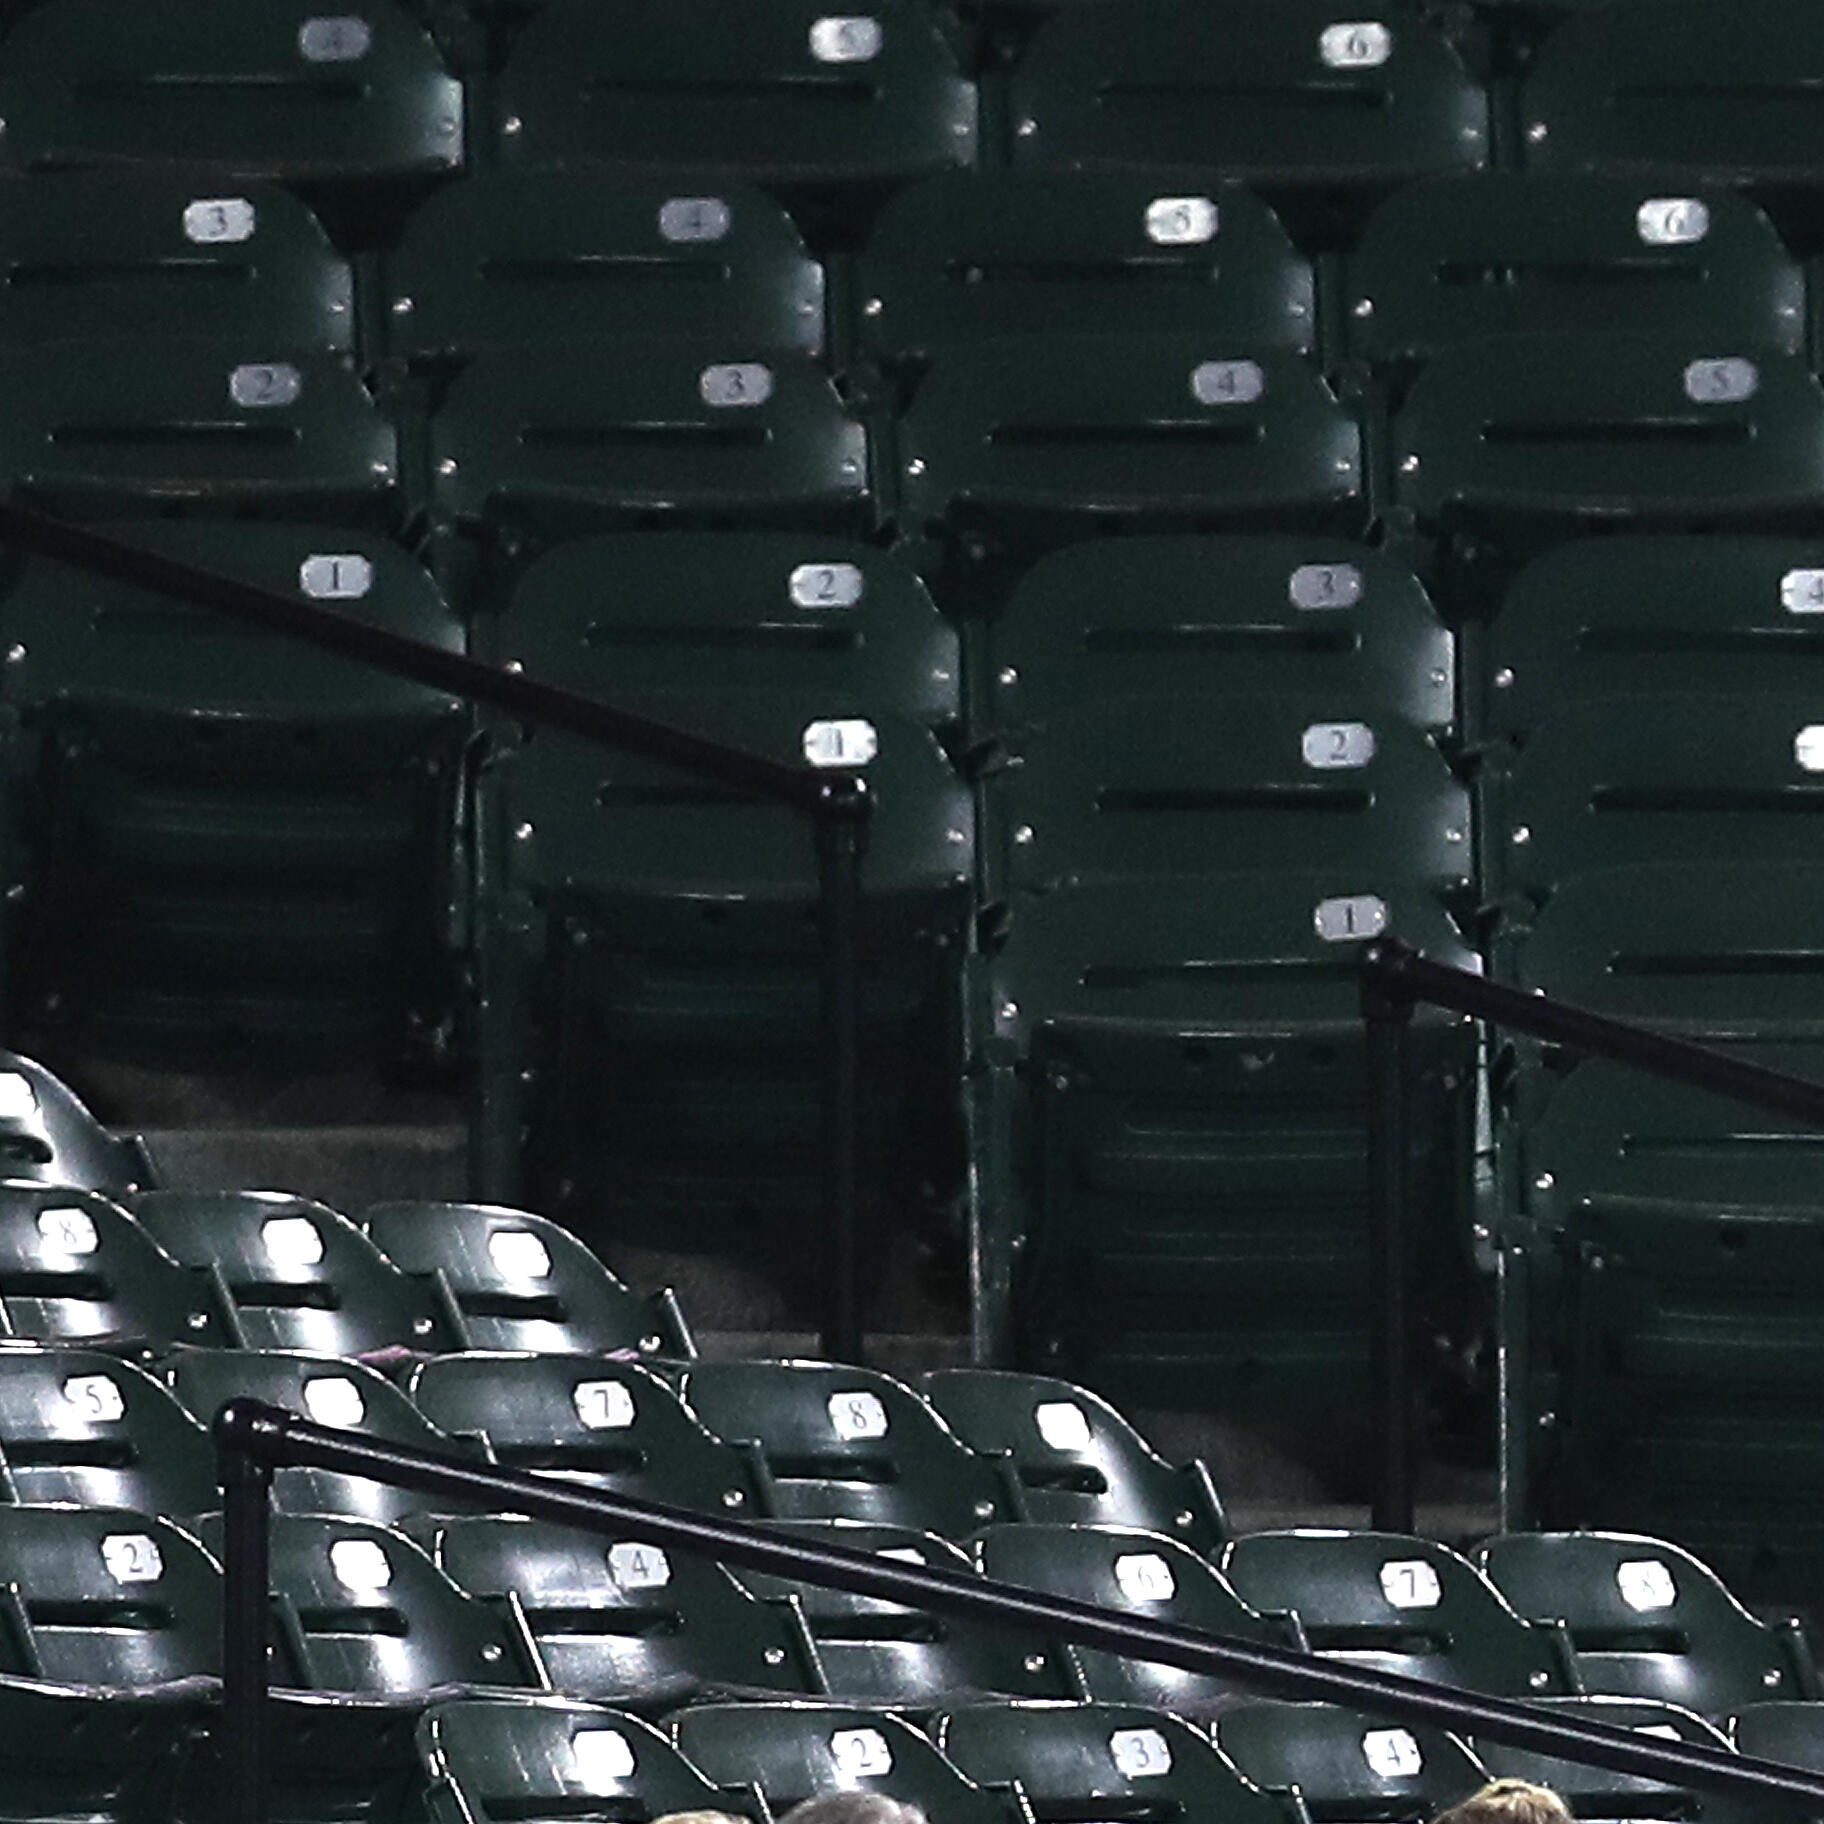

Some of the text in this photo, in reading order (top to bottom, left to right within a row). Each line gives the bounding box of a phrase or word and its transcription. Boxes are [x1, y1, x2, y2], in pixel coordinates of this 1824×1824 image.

[1348, 29, 1367, 57] 6
[208, 207, 228, 236] 3
[1666, 206, 1684, 234] 6
[256, 369, 274, 400] 2
[728, 369, 745, 399] 3
[1217, 369, 1234, 397] 4
[331, 561, 341, 591] 1
[818, 570, 837, 600] 2
[1317, 571, 1334, 601] 3
[1809, 577, 1824, 605] 4
[836, 728, 846, 758] 1
[1331, 730, 1348, 761] 2
[1345, 903, 1354, 933] 1
[61, 1217, 80, 1245] 8
[86, 1383, 103, 1415] 5
[593, 1388, 609, 1419] 7
[848, 1399, 868, 1429] 8
[122, 1542, 144, 1573] 2
[632, 1550, 650, 1579] 4
[1136, 1563, 1155, 1591] 6
[1399, 1568, 1416, 1599] 7
[851, 1736, 874, 1768] 2
[1131, 1736, 1150, 1768] 3
[1386, 1738, 1401, 1767] 4
